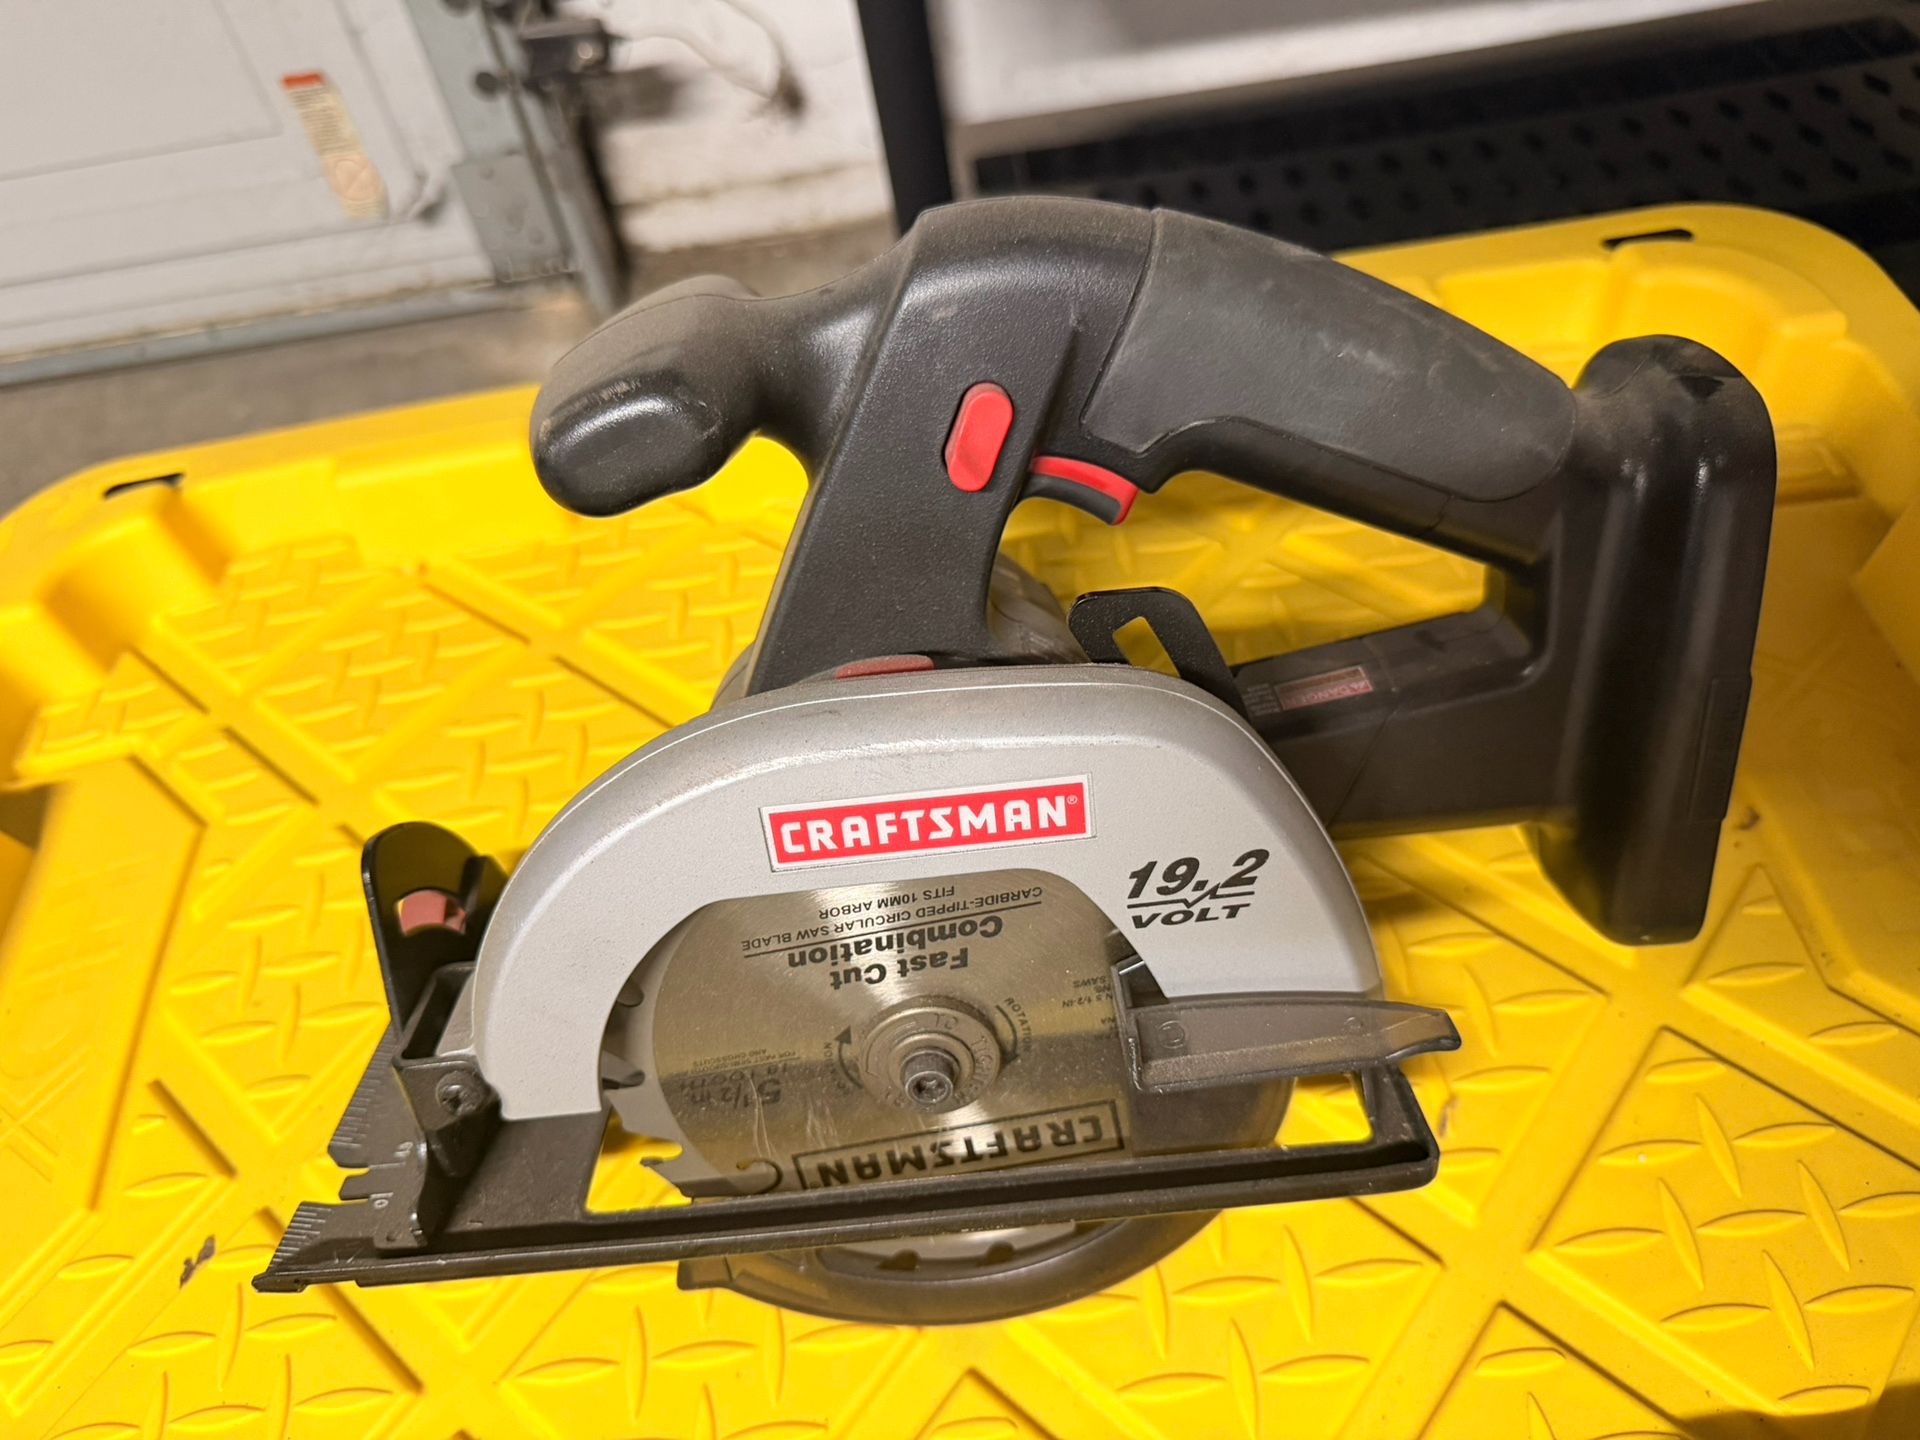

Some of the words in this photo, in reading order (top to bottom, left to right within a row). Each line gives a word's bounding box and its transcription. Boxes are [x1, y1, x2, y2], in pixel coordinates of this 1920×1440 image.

[1127, 848, 1270, 899] 19.2
[877, 892, 918, 909] 10MM
[915, 886, 1043, 919] CARBIDE-TIPPED
[922, 885, 956, 900] FITS
[818, 900, 873, 919] ARBOR
[834, 910, 911, 934] CIRCULAR
[1131, 902, 1252, 929] VOLT
[741, 932, 792, 951] BLADE
[788, 915, 1003, 967] Combination
[796, 925, 830, 941] SAW
[897, 947, 969, 977] Fast
[830, 963, 887, 990] Cut
[817, 1114, 1104, 1188] CRAFTSMAN
